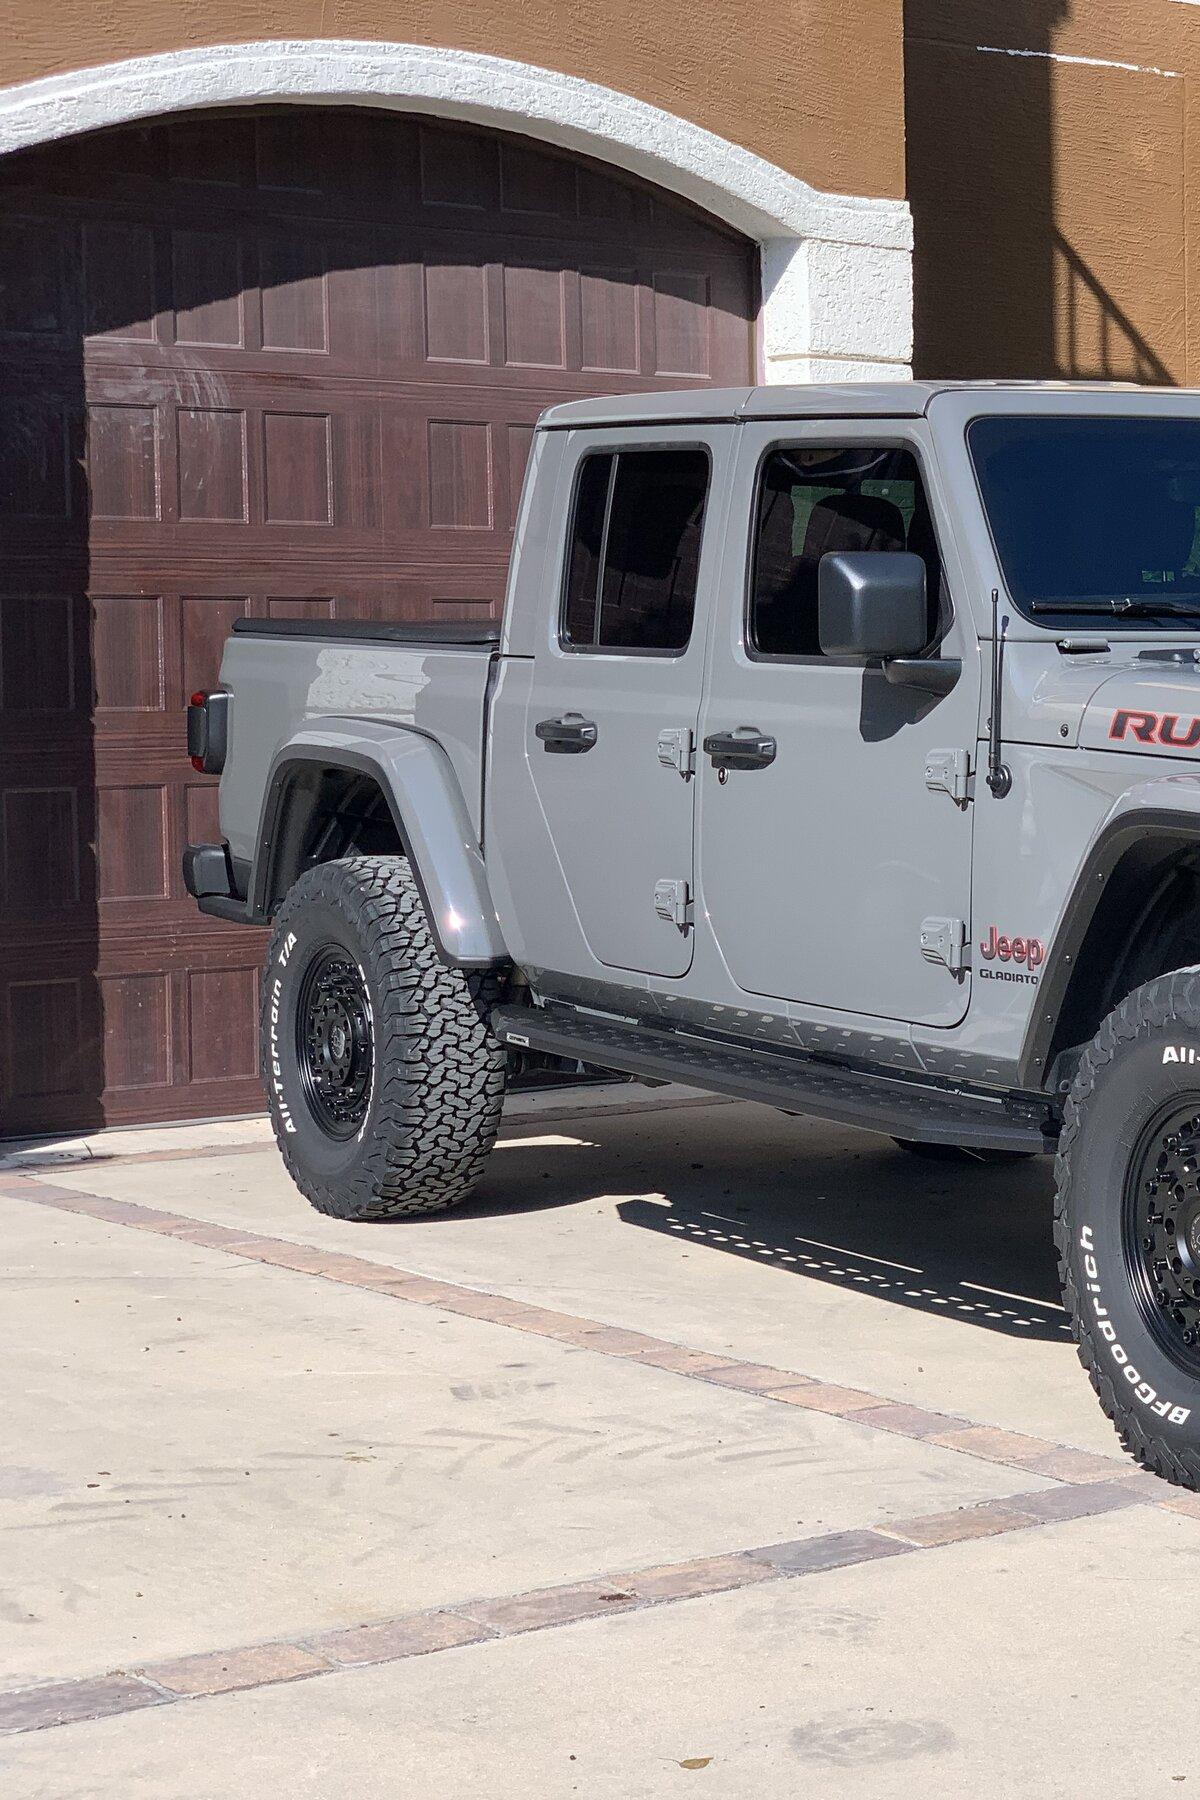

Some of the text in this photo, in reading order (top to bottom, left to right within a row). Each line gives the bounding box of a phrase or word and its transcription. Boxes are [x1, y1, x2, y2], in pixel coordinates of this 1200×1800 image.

[979, 968, 1039, 985] GLADIATO
[980, 926, 1044, 971] Jeep
[270, 931, 298, 1133] All-Terrain T/A
[1080, 1225, 1191, 1425] BFGoodrich
